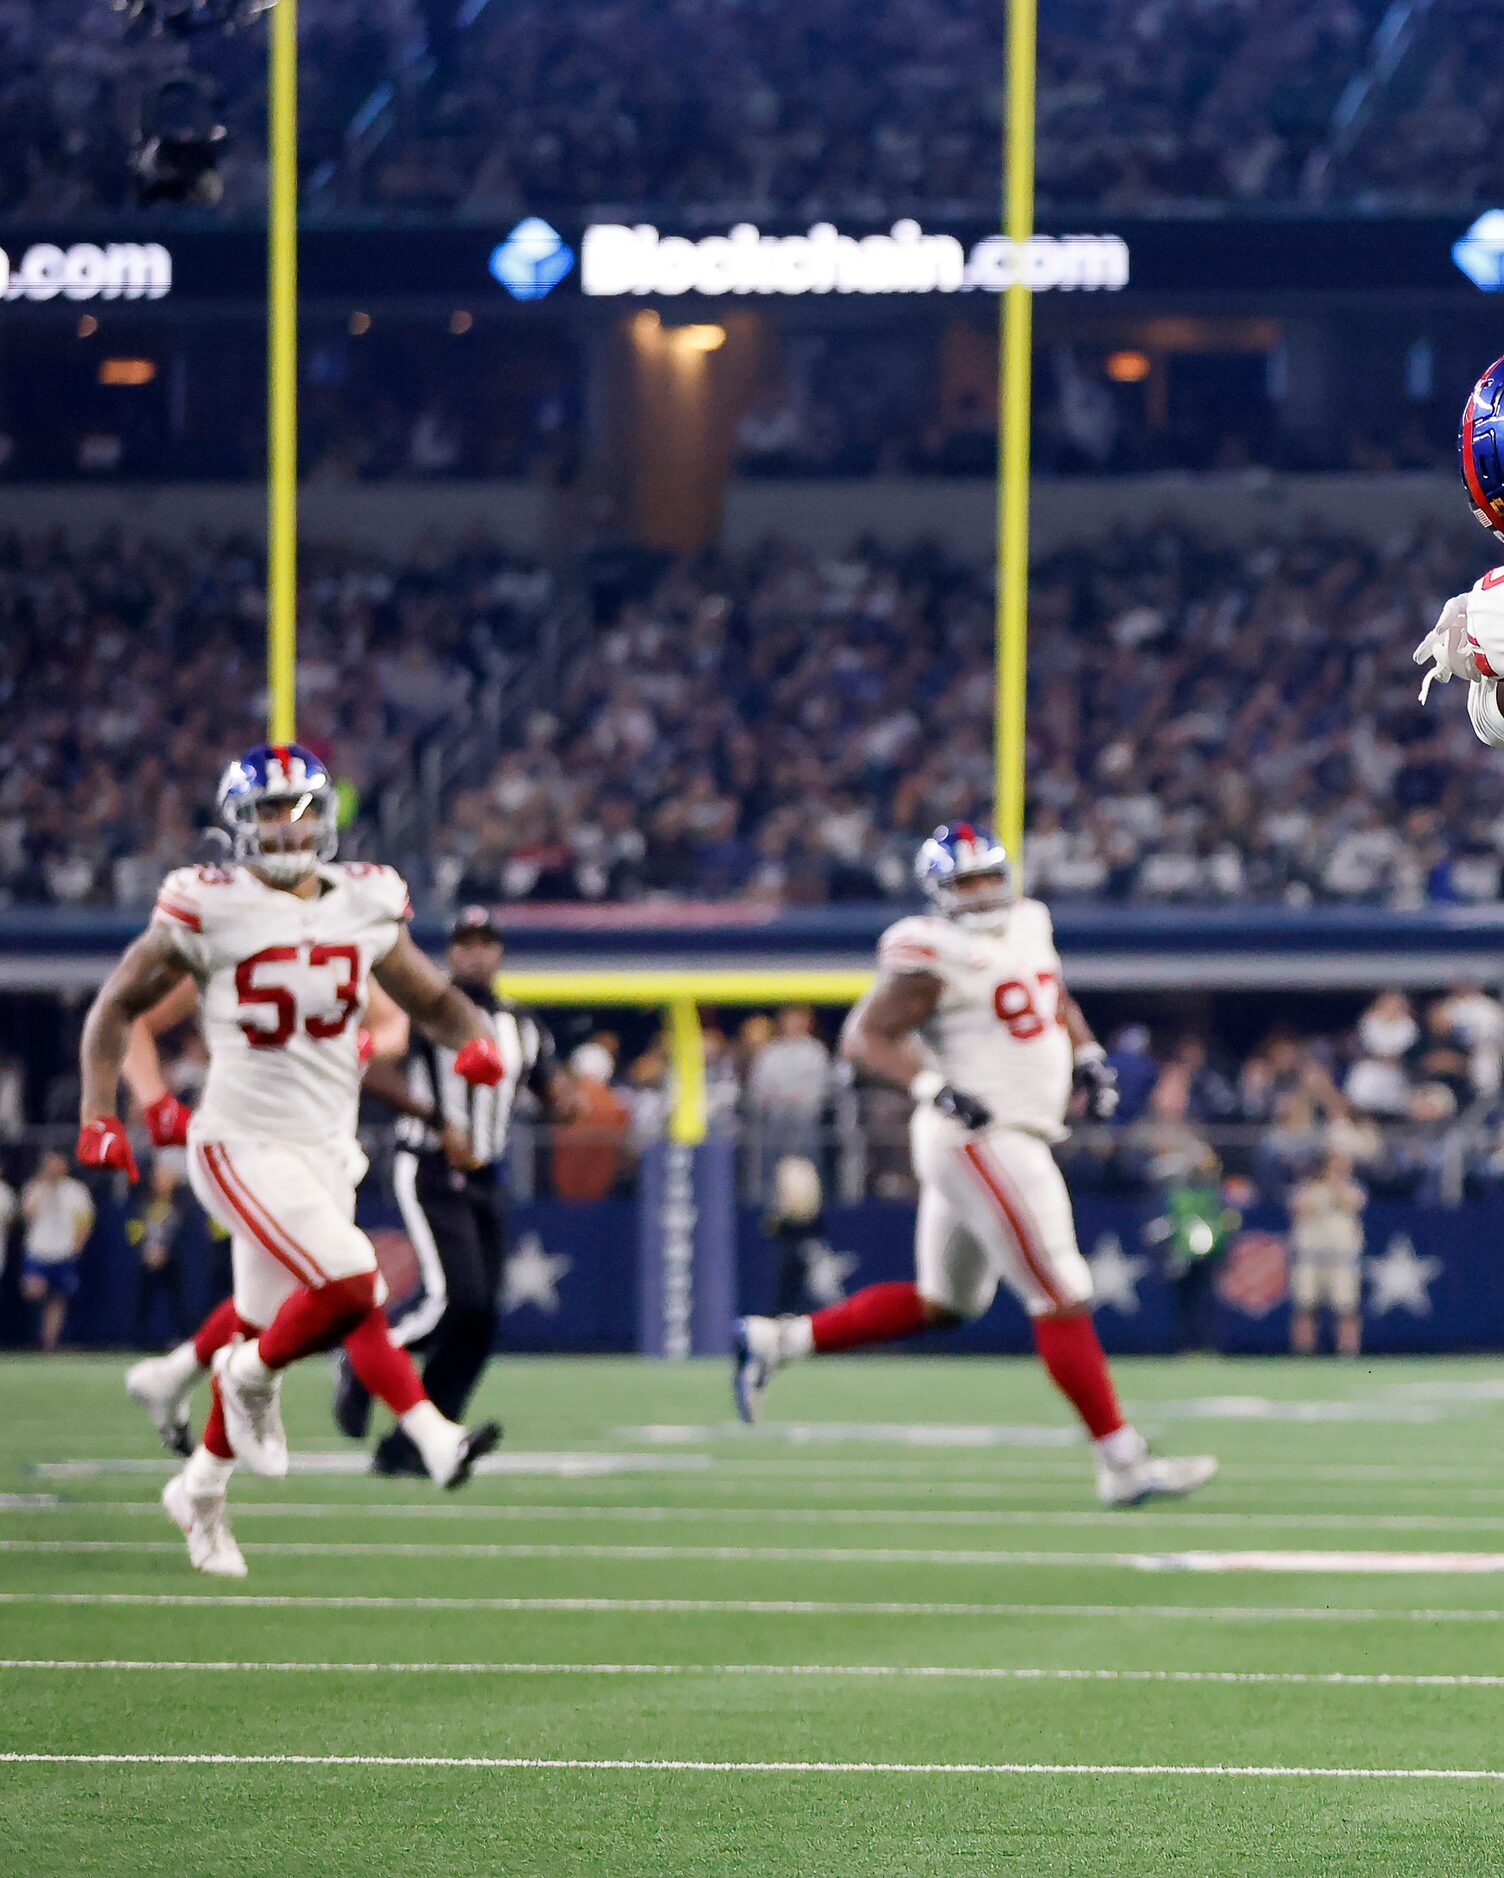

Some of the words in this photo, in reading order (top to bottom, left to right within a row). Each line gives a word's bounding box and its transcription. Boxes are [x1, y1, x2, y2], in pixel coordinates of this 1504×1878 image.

[0, 242, 173, 301] .com
[581, 219, 1129, 296] Blockchain.com
[236, 944, 360, 1048] 53
